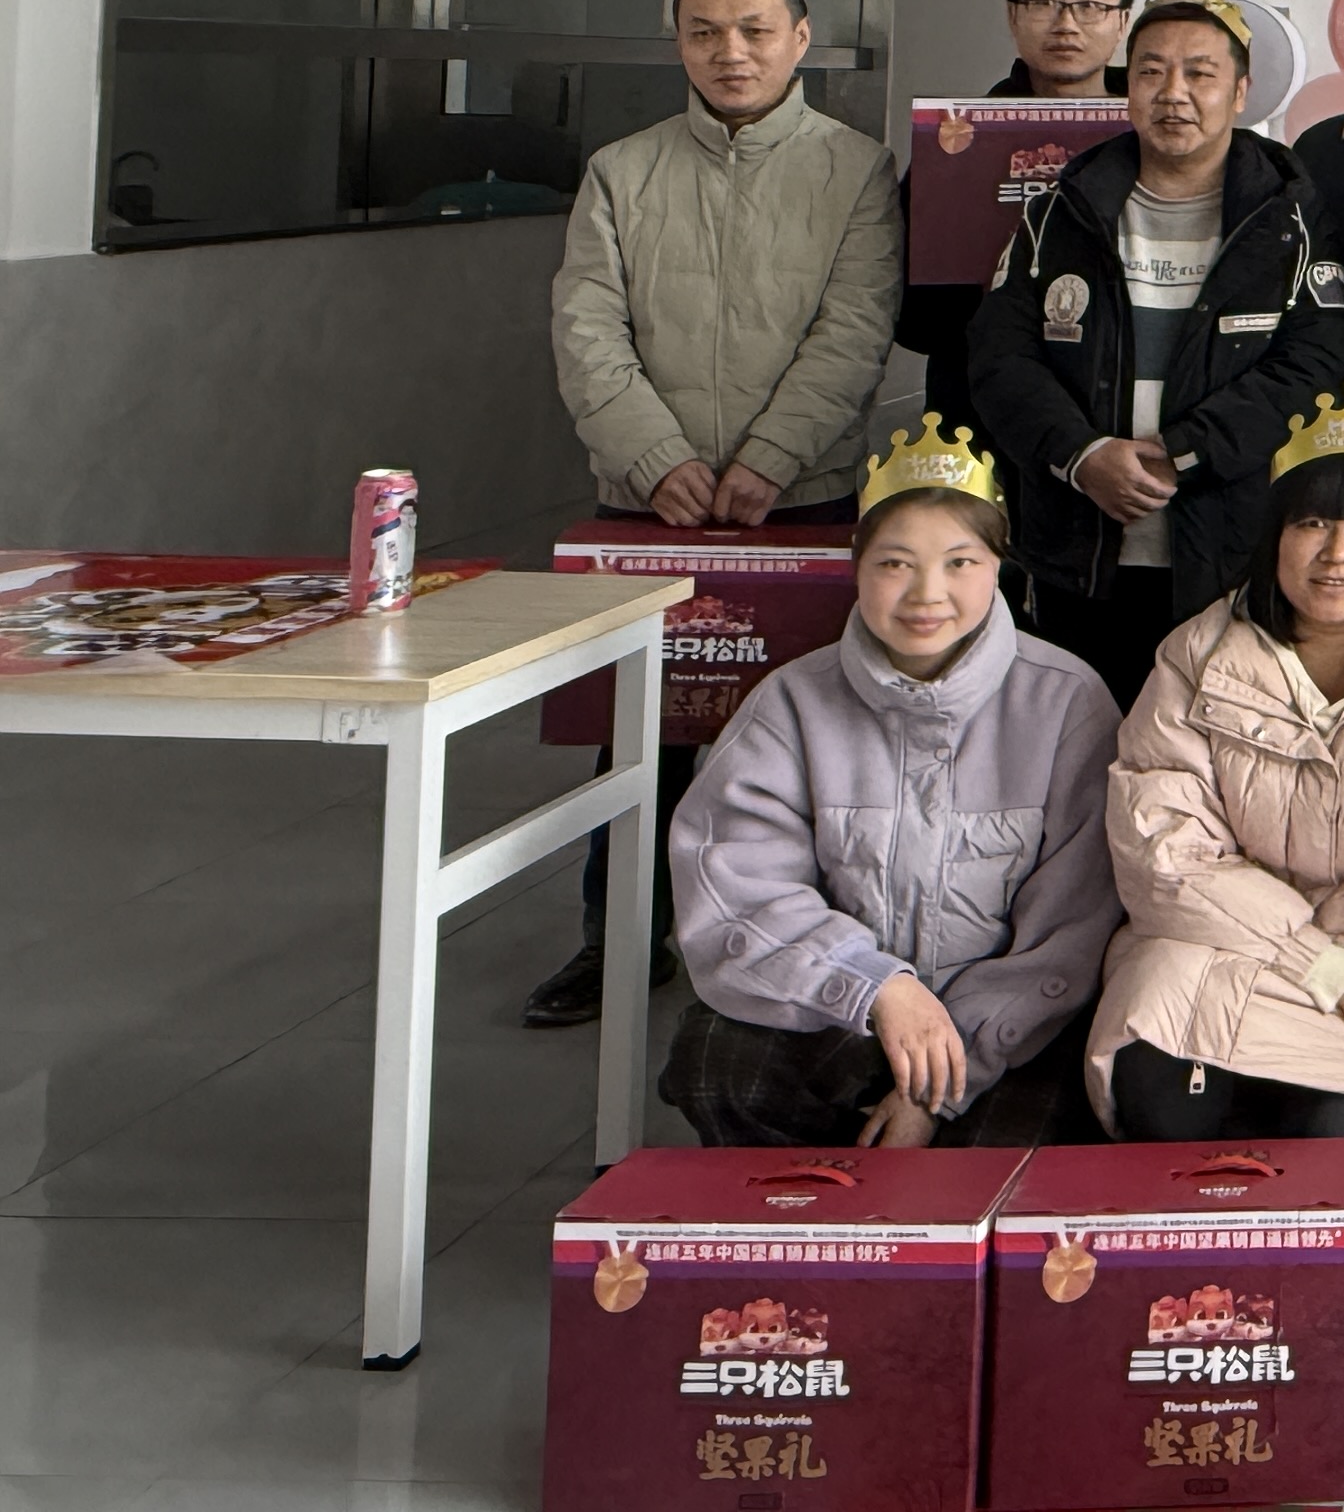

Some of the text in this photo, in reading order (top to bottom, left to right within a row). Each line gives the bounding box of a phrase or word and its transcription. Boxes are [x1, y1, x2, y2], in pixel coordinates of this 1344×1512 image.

[679, 1359, 850, 1398] 三只松鼠
[1128, 1344, 1295, 1384] 三只松鼠
